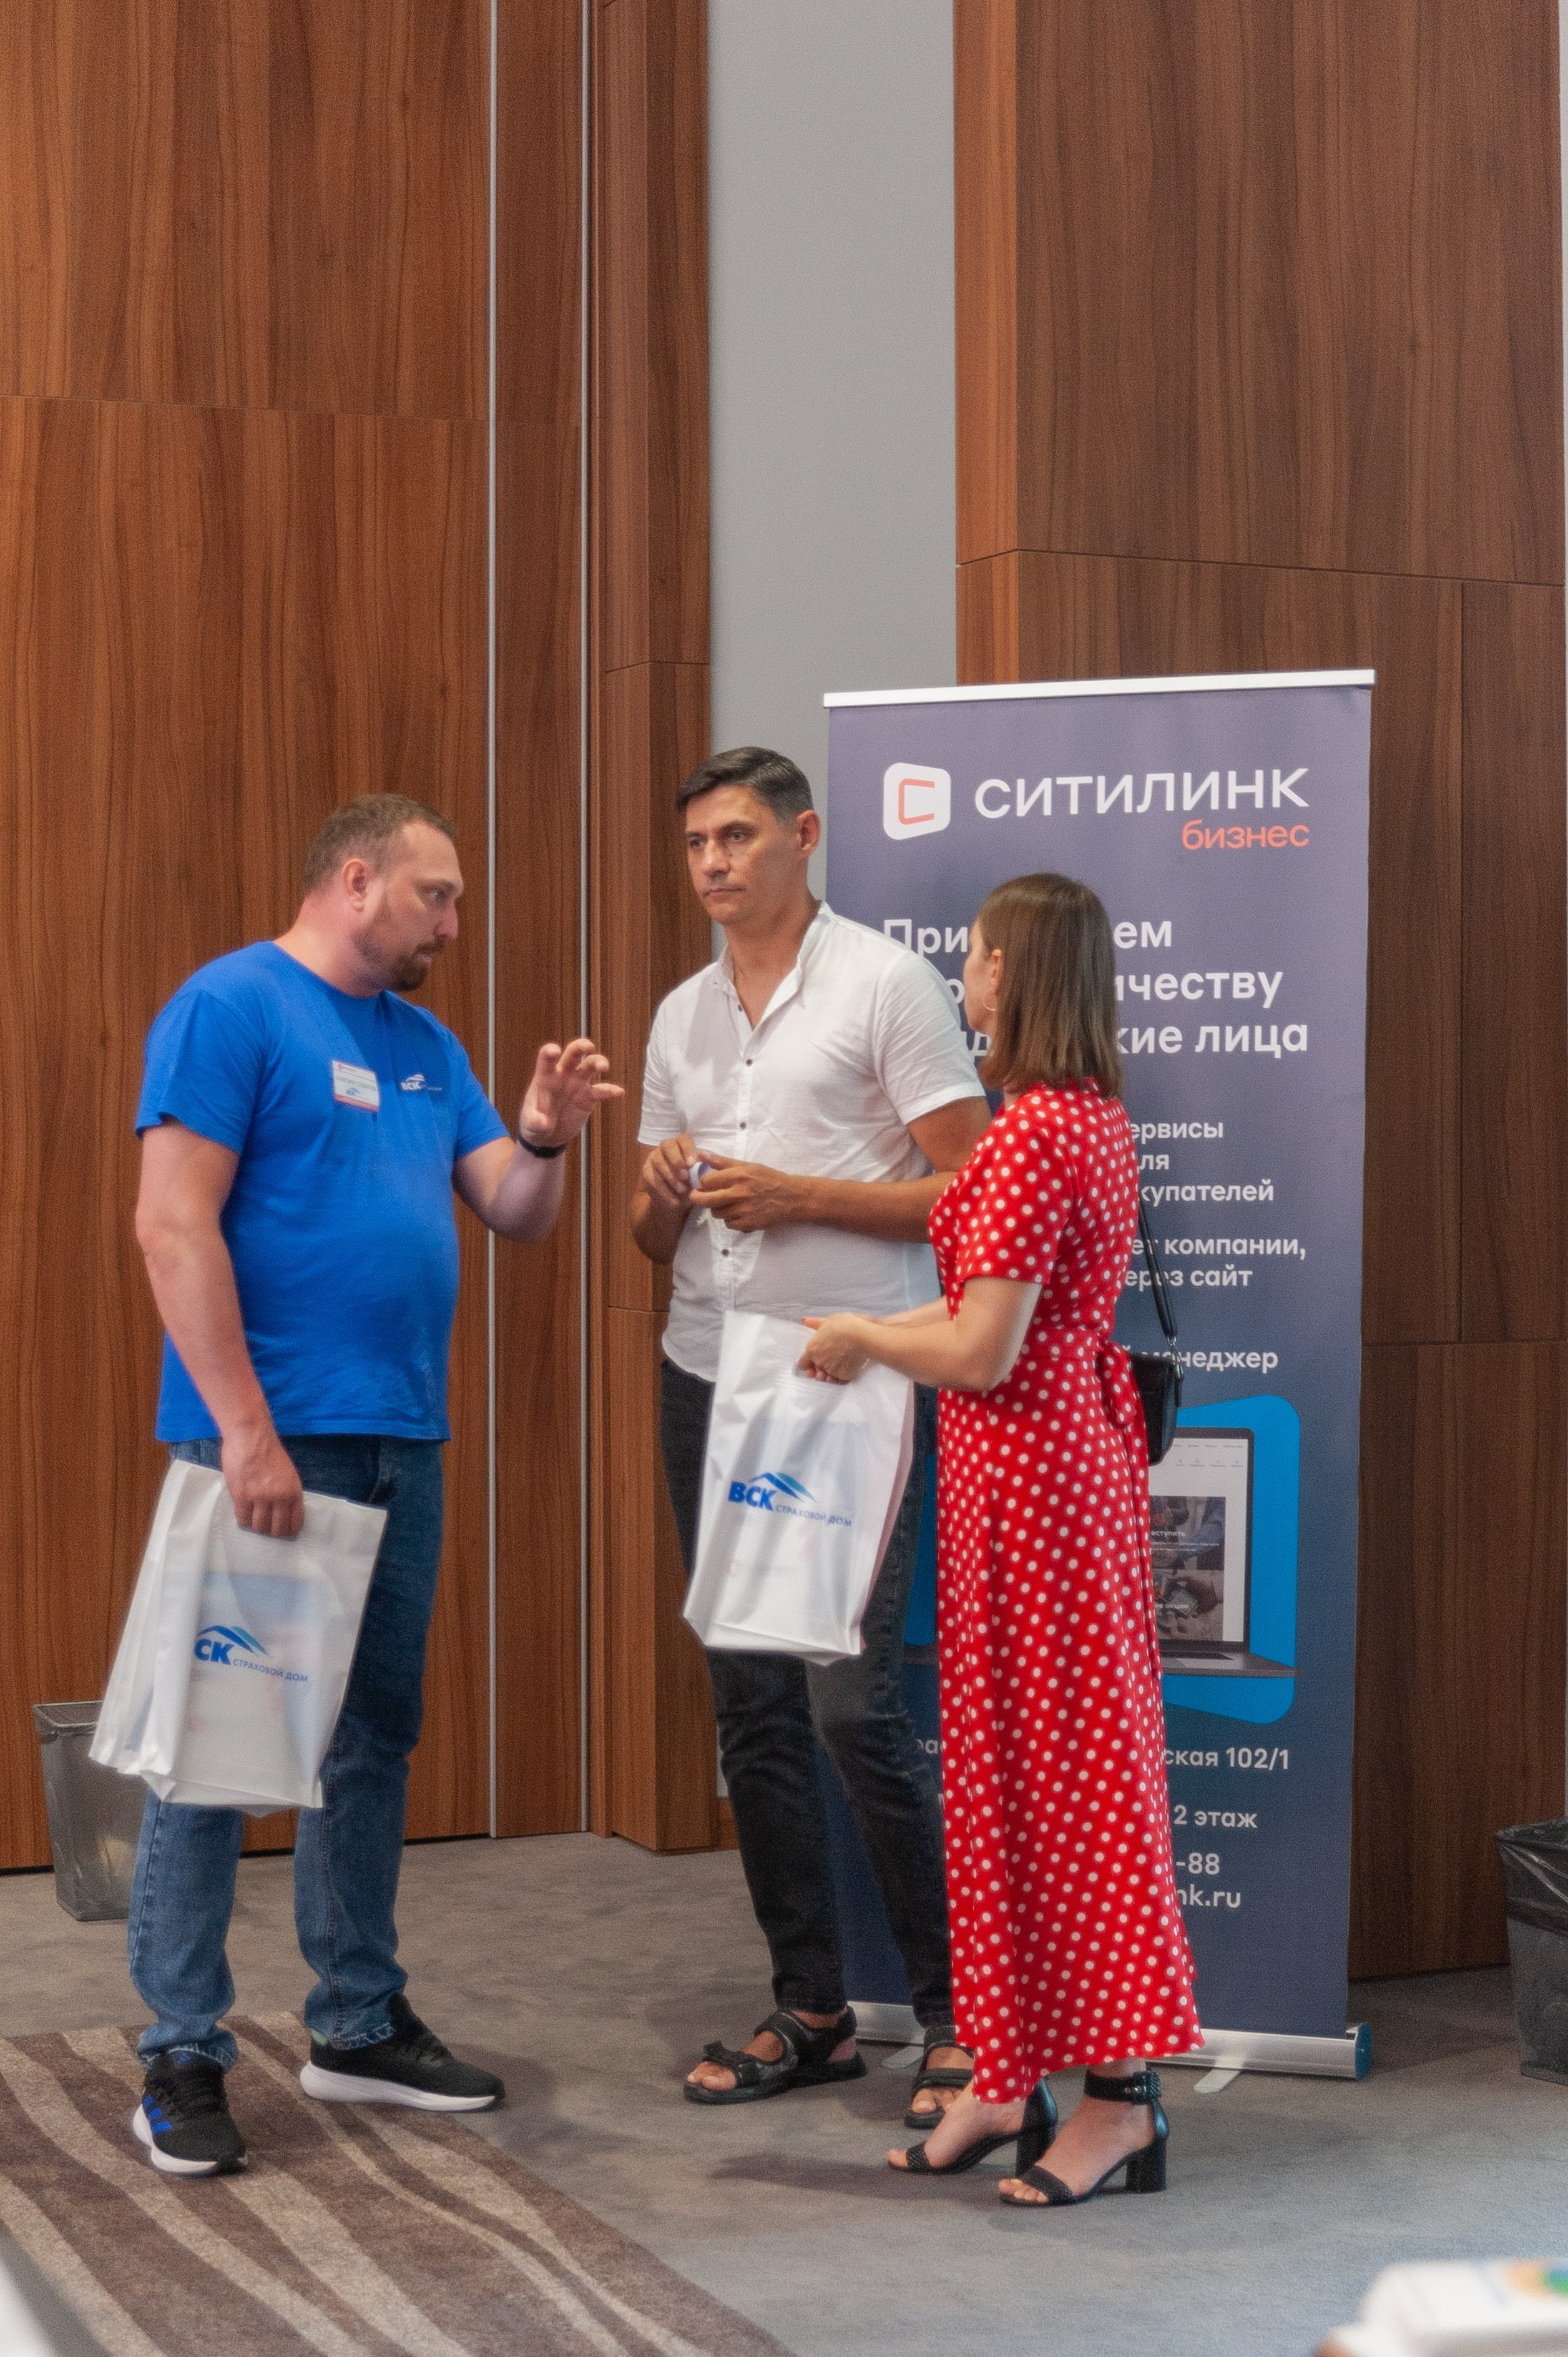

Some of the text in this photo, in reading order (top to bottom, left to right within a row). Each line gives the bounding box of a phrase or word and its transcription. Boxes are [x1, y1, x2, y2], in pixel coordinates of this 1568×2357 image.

[974, 767, 1310, 819] СИТИЛИНК
[1182, 819, 1310, 850] бизнес
[1195, 1024, 1308, 1058] лица
[1130, 1122, 1223, 1144] ервисы
[1139, 1154, 1170, 1170] ля
[1140, 1178, 1274, 1207] купателей
[1165, 1239, 1306, 1261] компании,
[1191, 1264, 1253, 1286] сайт
[728, 1481, 777, 1511] ВСК
[828, 1515, 851, 1527] ДОМ
[194, 1638, 308, 1683] СК СТРАХОВОЙ ДОМ
[1165, 1748, 1289, 1771] ская 102/1
[1174, 1804, 1258, 1829] 2 этаж
[1176, 1852, 1220, 1875] -88
[1177, 1883, 1241, 1908] nk.ru
